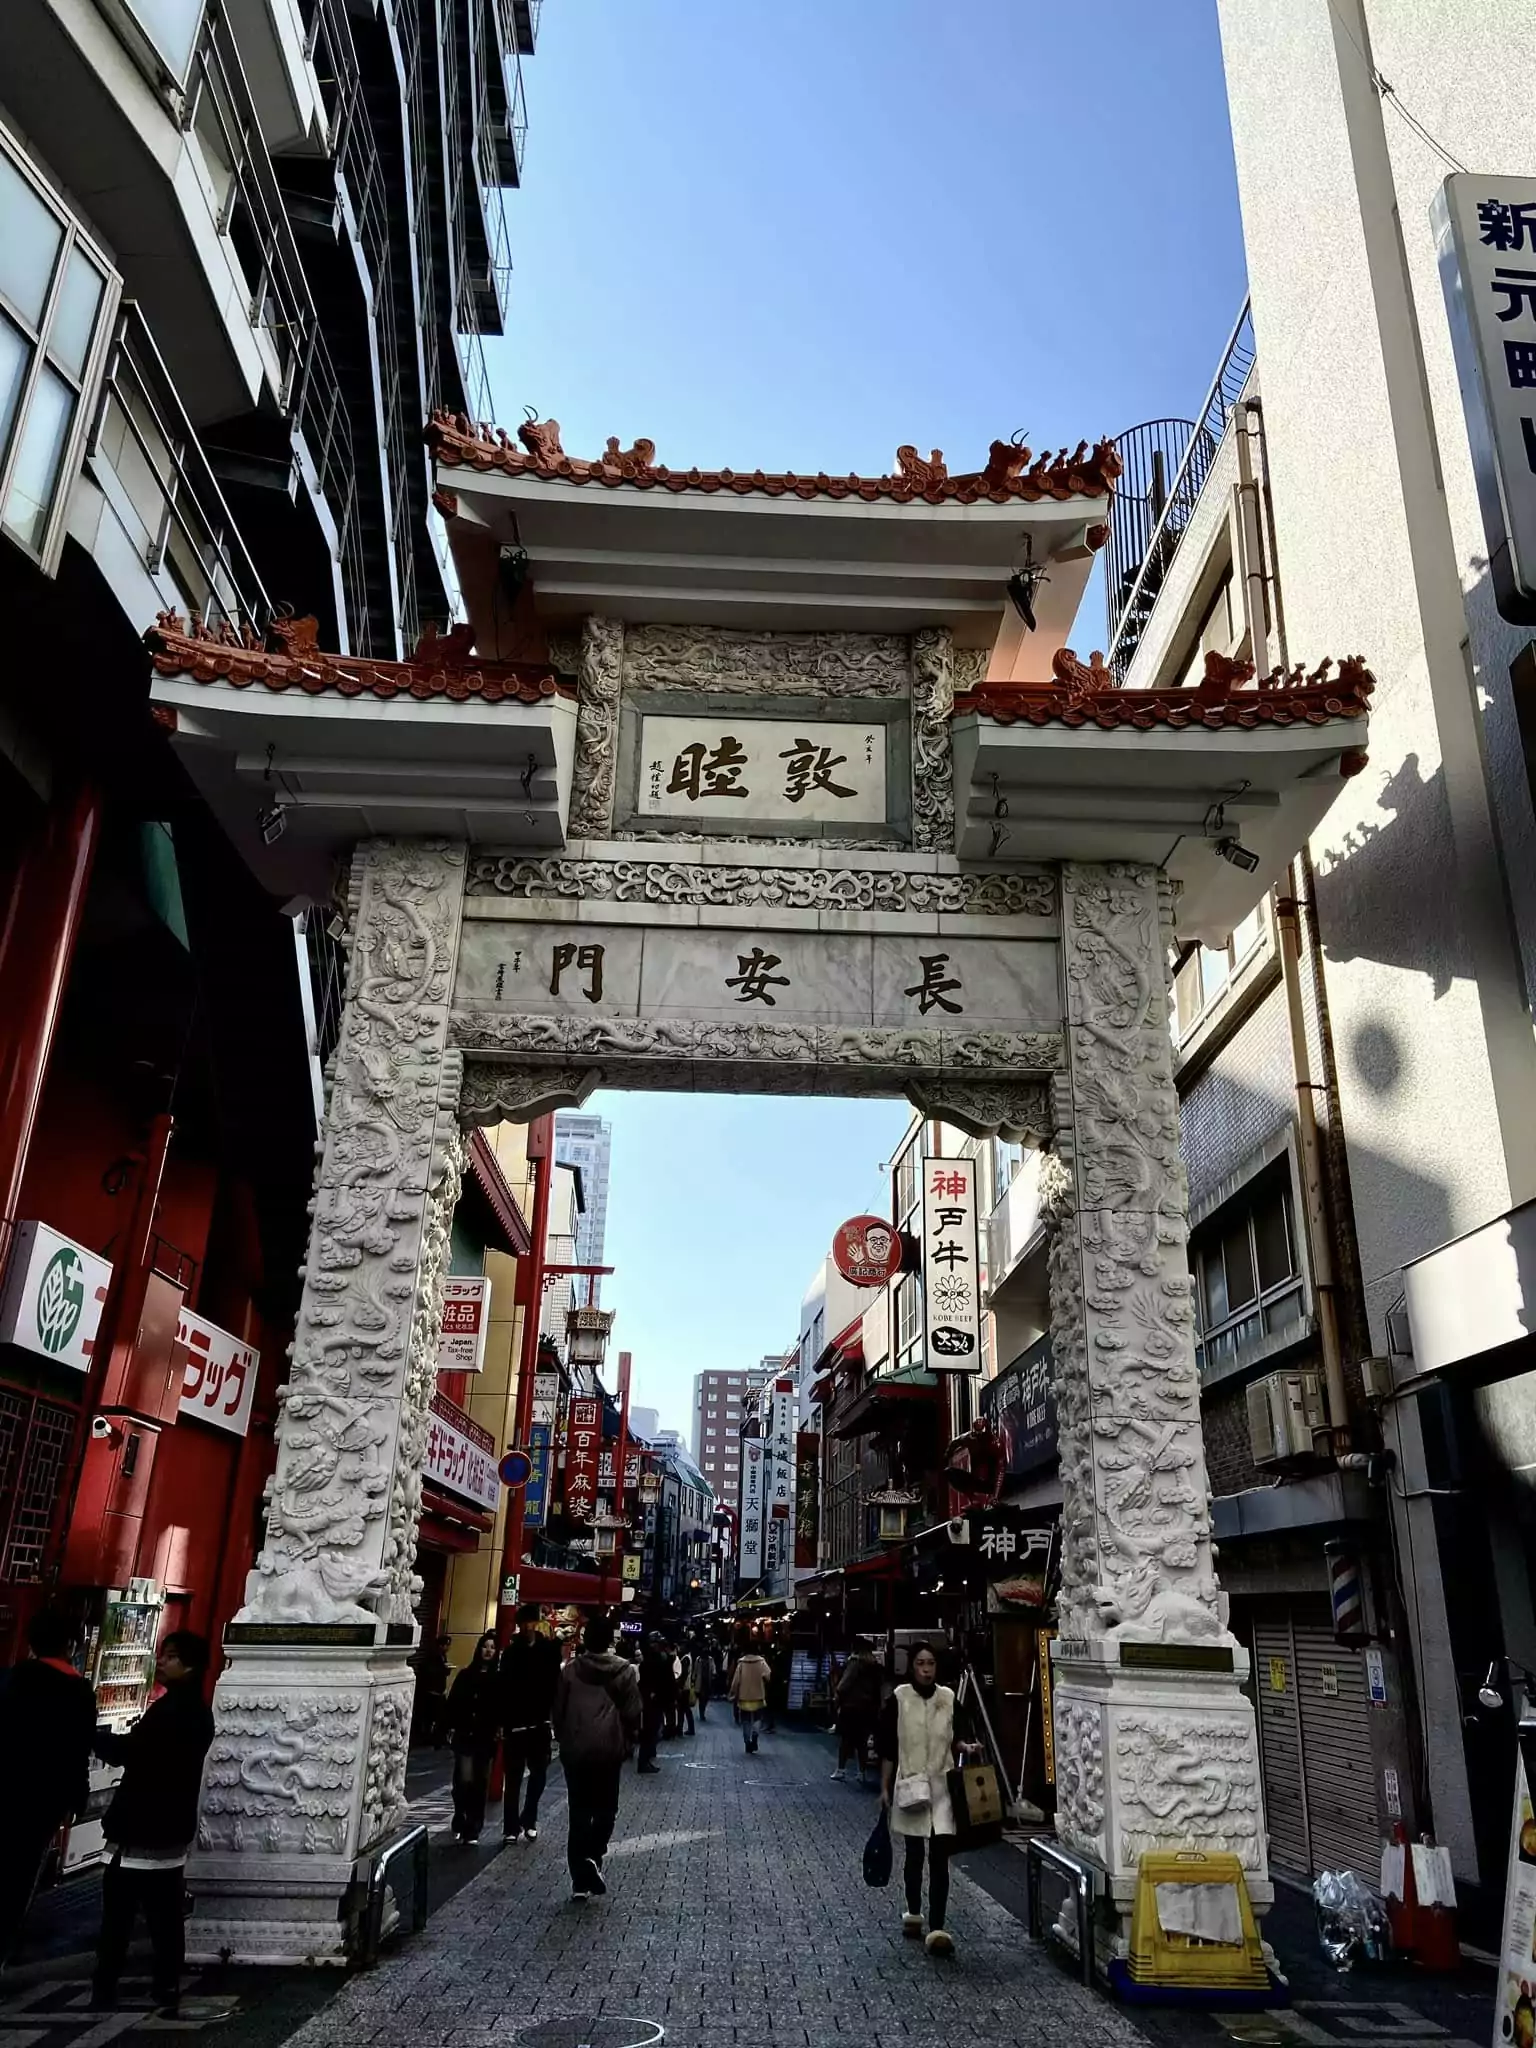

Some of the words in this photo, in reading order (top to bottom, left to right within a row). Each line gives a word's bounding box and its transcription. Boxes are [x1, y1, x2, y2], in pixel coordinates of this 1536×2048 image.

[549, 942, 963, 1015] 長安門
[930, 1171, 969, 1272] 神戸牛
[932, 1314, 952, 1322] KOBE
[954, 1315, 973, 1323] BEEF
[456, 1353, 473, 1361] Shop
[568, 1430, 596, 1517] 百年麻婆
[776, 1432, 788, 1497] 長城飯店
[979, 1526, 1053, 1561] 神戸
